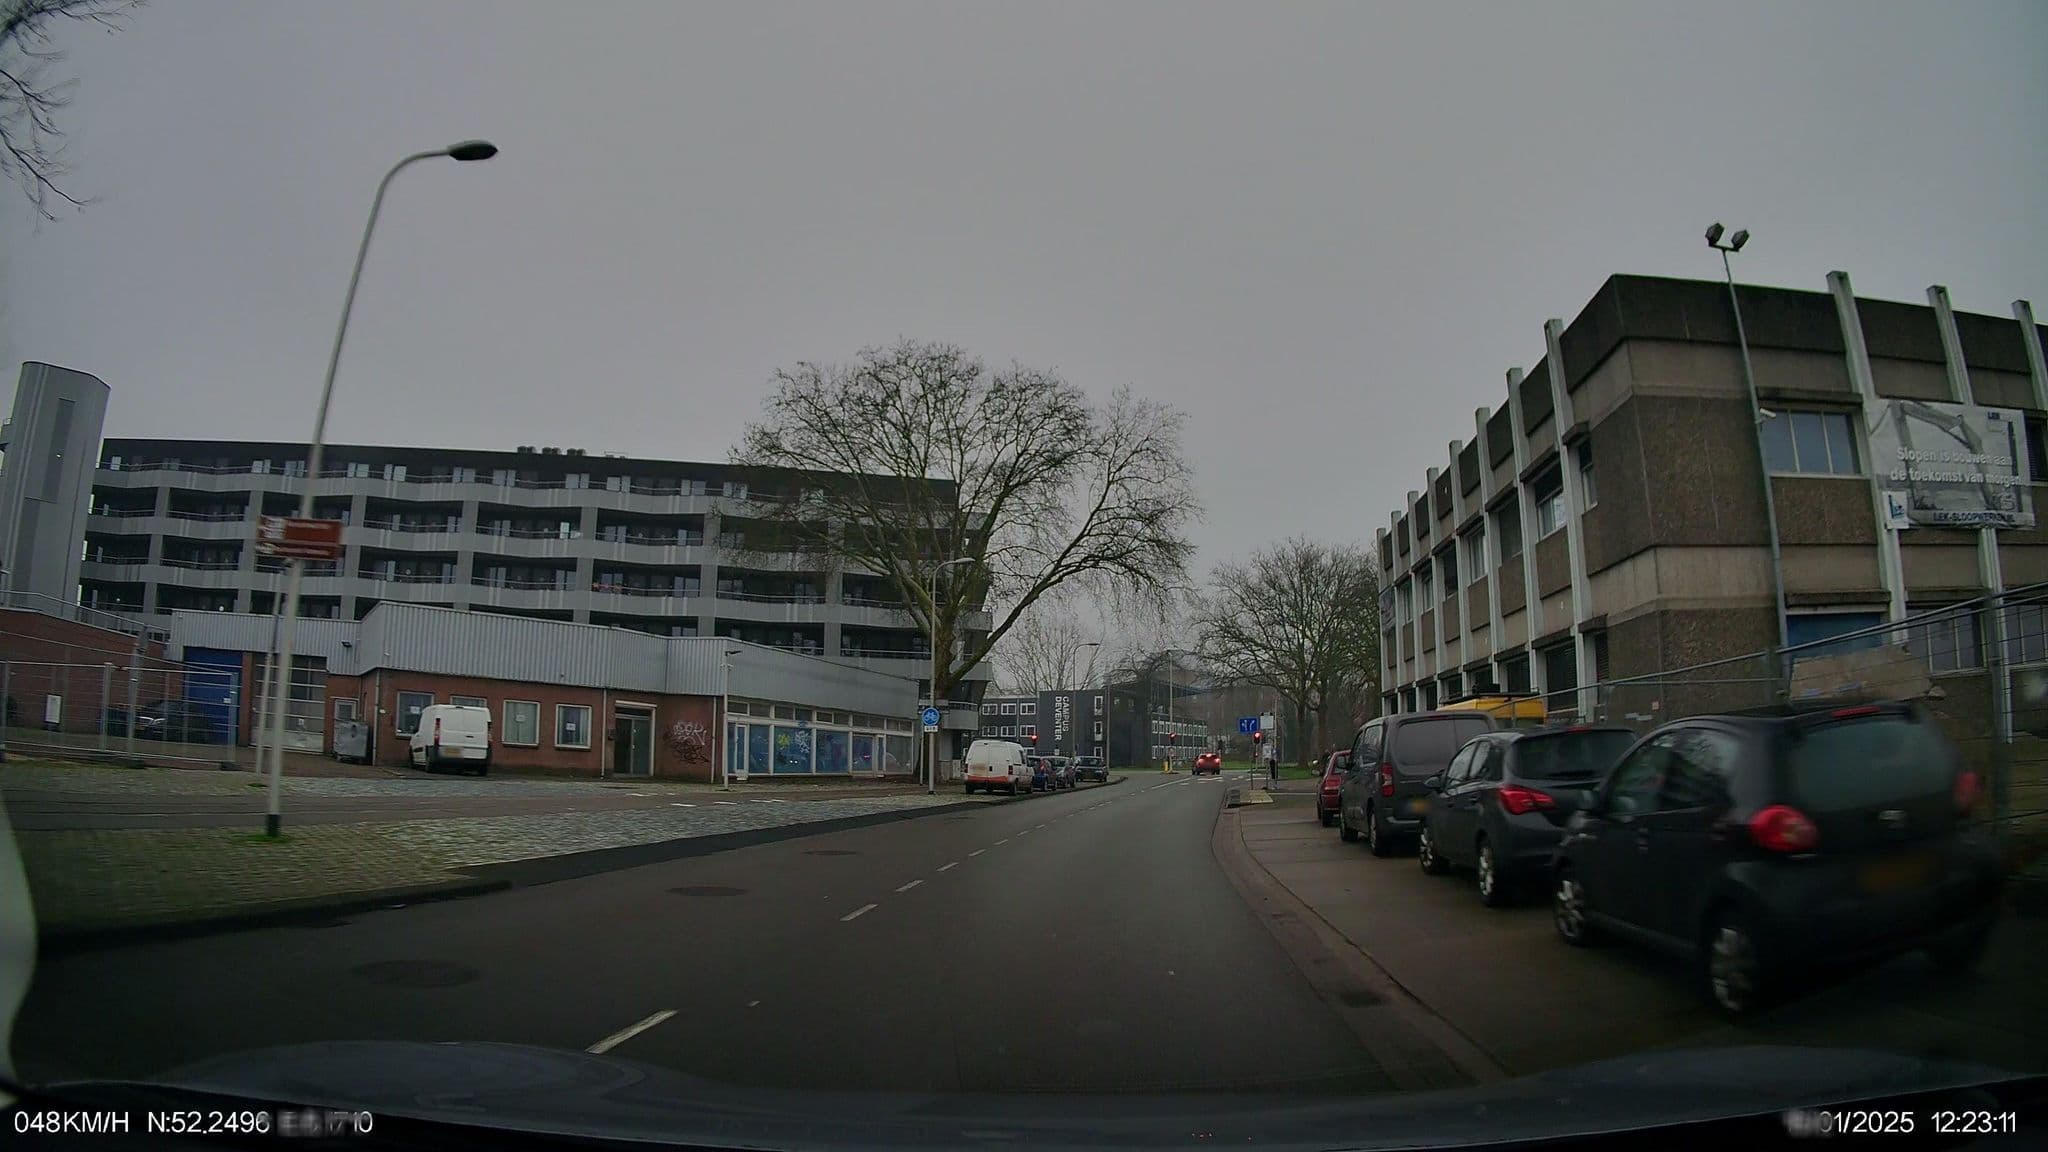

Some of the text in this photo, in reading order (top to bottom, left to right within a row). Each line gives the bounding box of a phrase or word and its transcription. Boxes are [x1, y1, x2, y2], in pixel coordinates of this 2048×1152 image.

[1896, 446, 1937, 464] Slopen
[1939, 449, 1951, 462] is
[1890, 467, 1906, 481] de
[1909, 467, 1963, 483] toekomst
[1965, 470, 1984, 484] van
[1055, 696, 1063, 741] DEVENTER
[1062, 696, 1070, 732] CAMPUS
